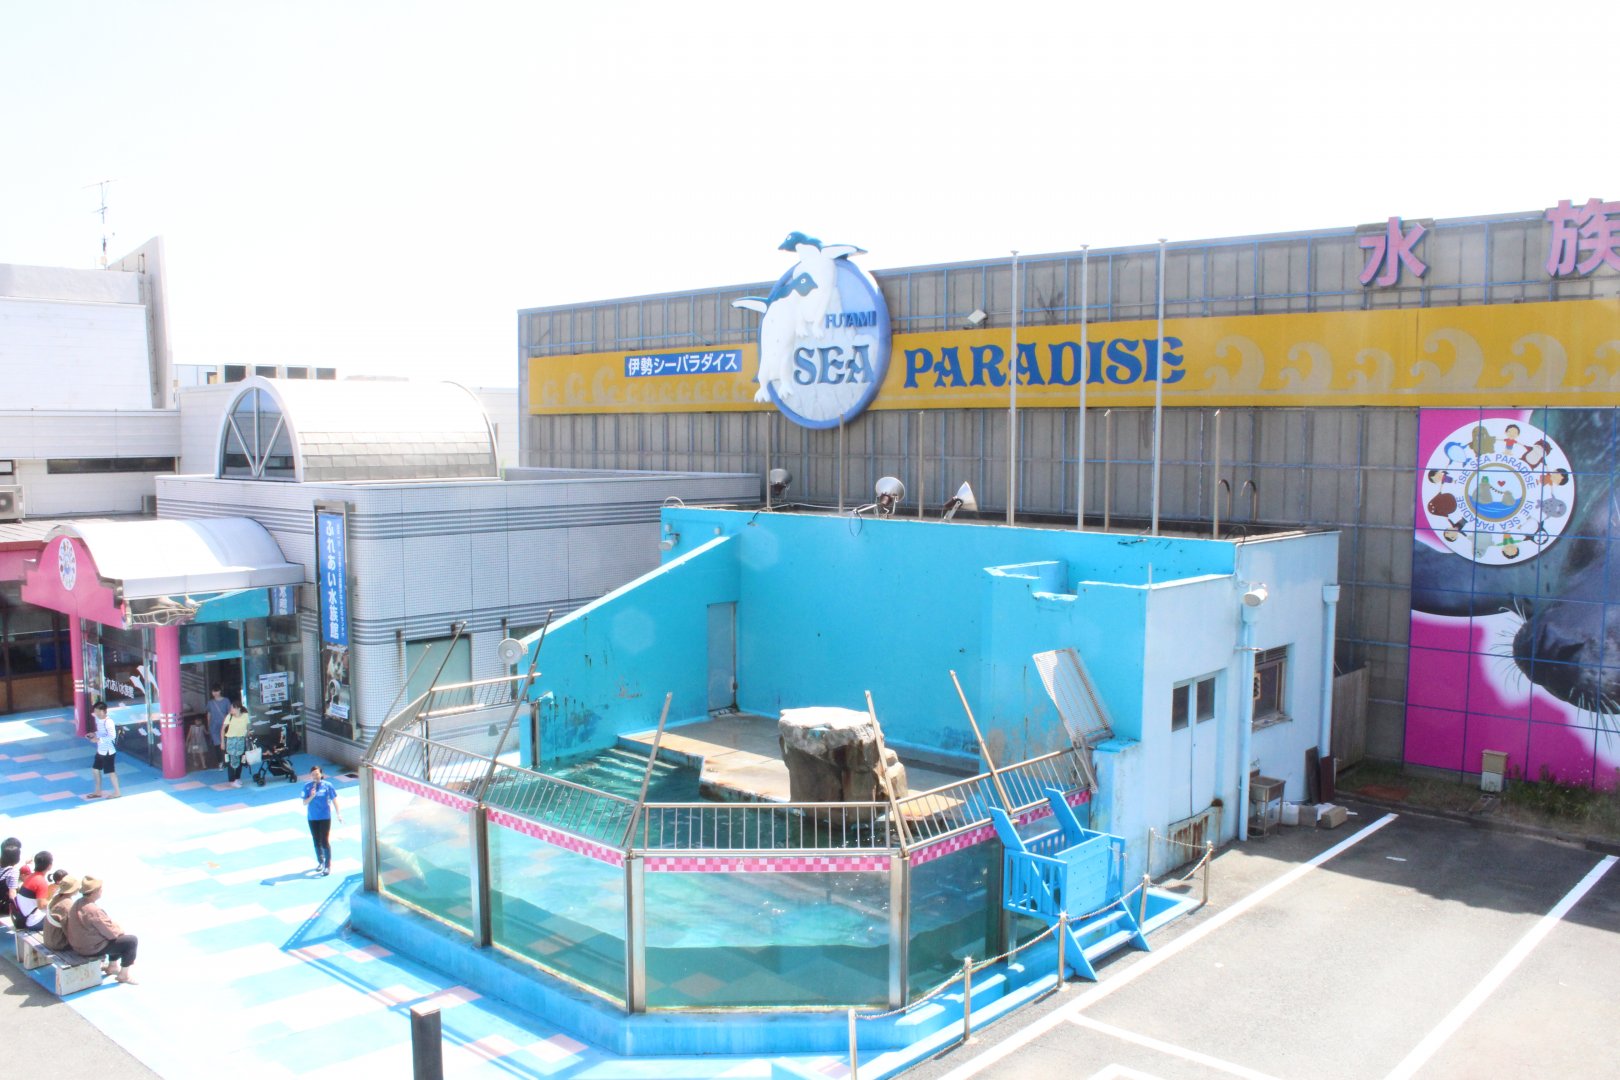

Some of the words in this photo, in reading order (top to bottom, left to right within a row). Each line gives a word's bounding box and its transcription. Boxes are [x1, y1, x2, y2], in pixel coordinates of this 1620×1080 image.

[825, 310, 877, 329] FUTAMI
[628, 353, 738, 376] 伊勢シーパラダイス
[794, 344, 875, 385] SEA
[903, 336, 1187, 389] PARADISE
[1457, 470, 1470, 485] ISE
[1470, 455, 1490, 469] SEA
[1496, 453, 1535, 489] PARADISE
[1456, 495, 1495, 531] PARADISE
[1500, 517, 1520, 530] SEA
[1520, 501, 1533, 518] ISE
[326, 521, 338, 640] ふれあい水族館
